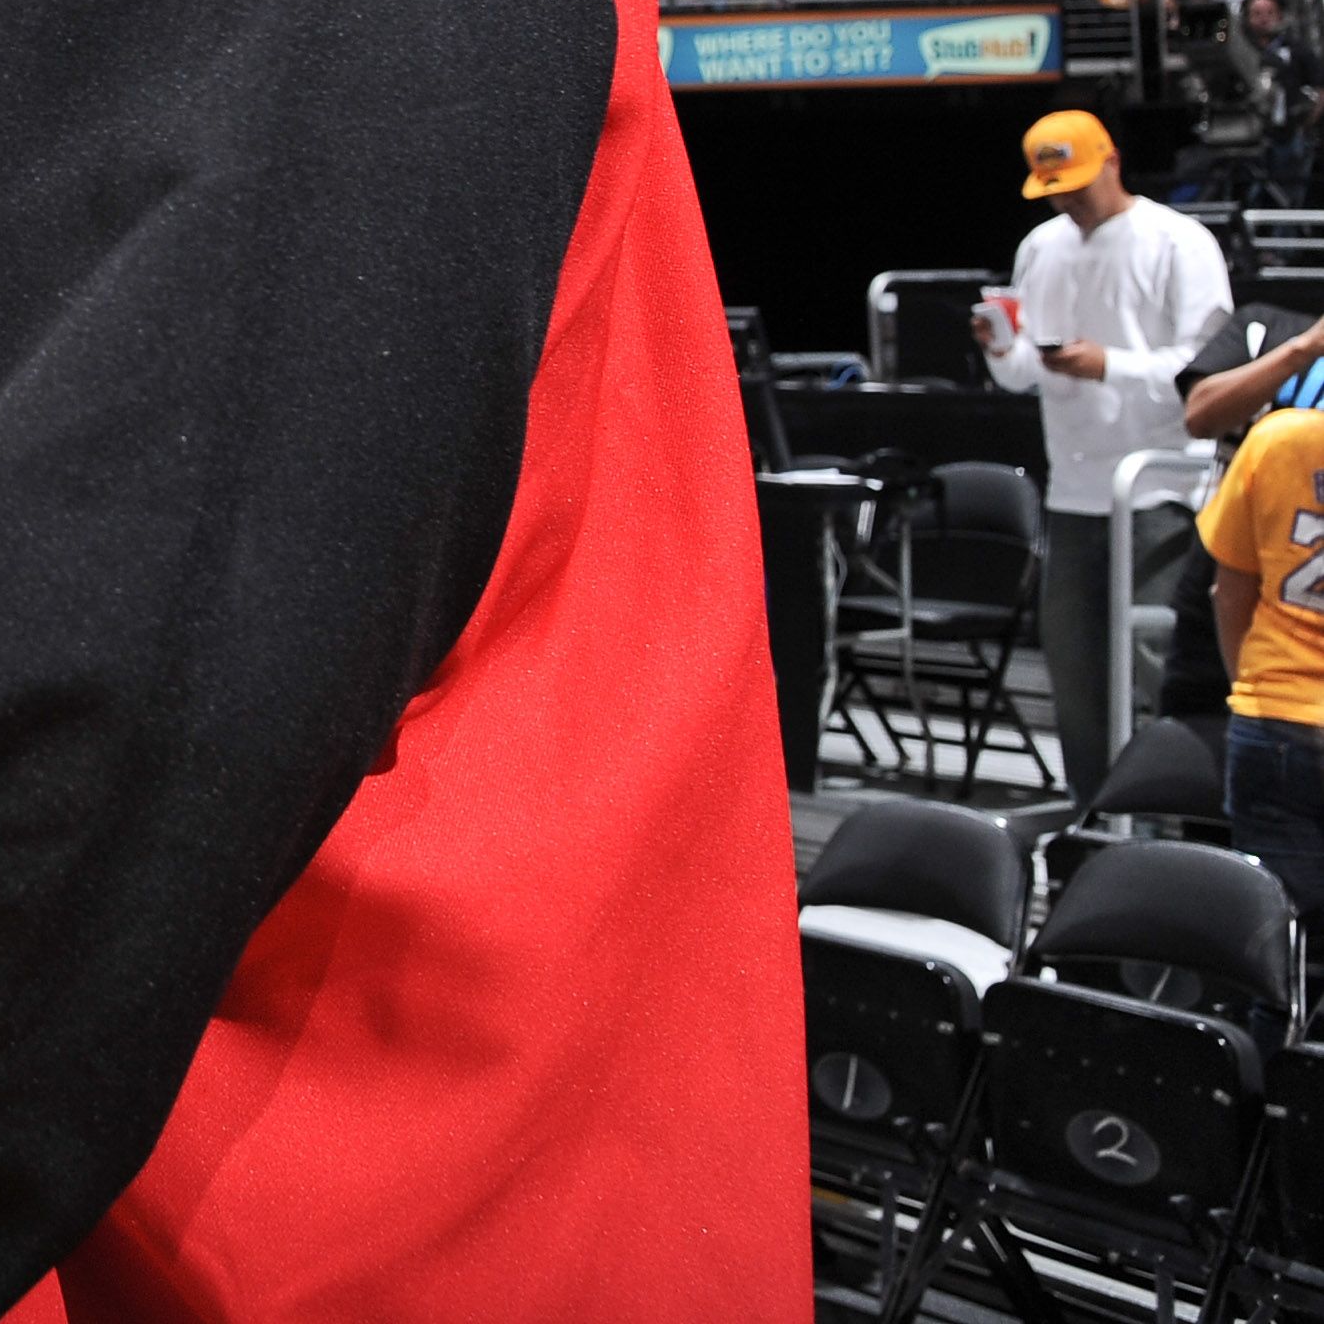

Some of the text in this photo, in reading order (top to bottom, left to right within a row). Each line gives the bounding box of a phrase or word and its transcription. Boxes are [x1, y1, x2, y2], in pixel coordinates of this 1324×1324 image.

[693, 20, 892, 55] WHERE DO YOU
[698, 45, 893, 84] WANT TO SIT?
[1092, 1116, 1139, 1167] 2
